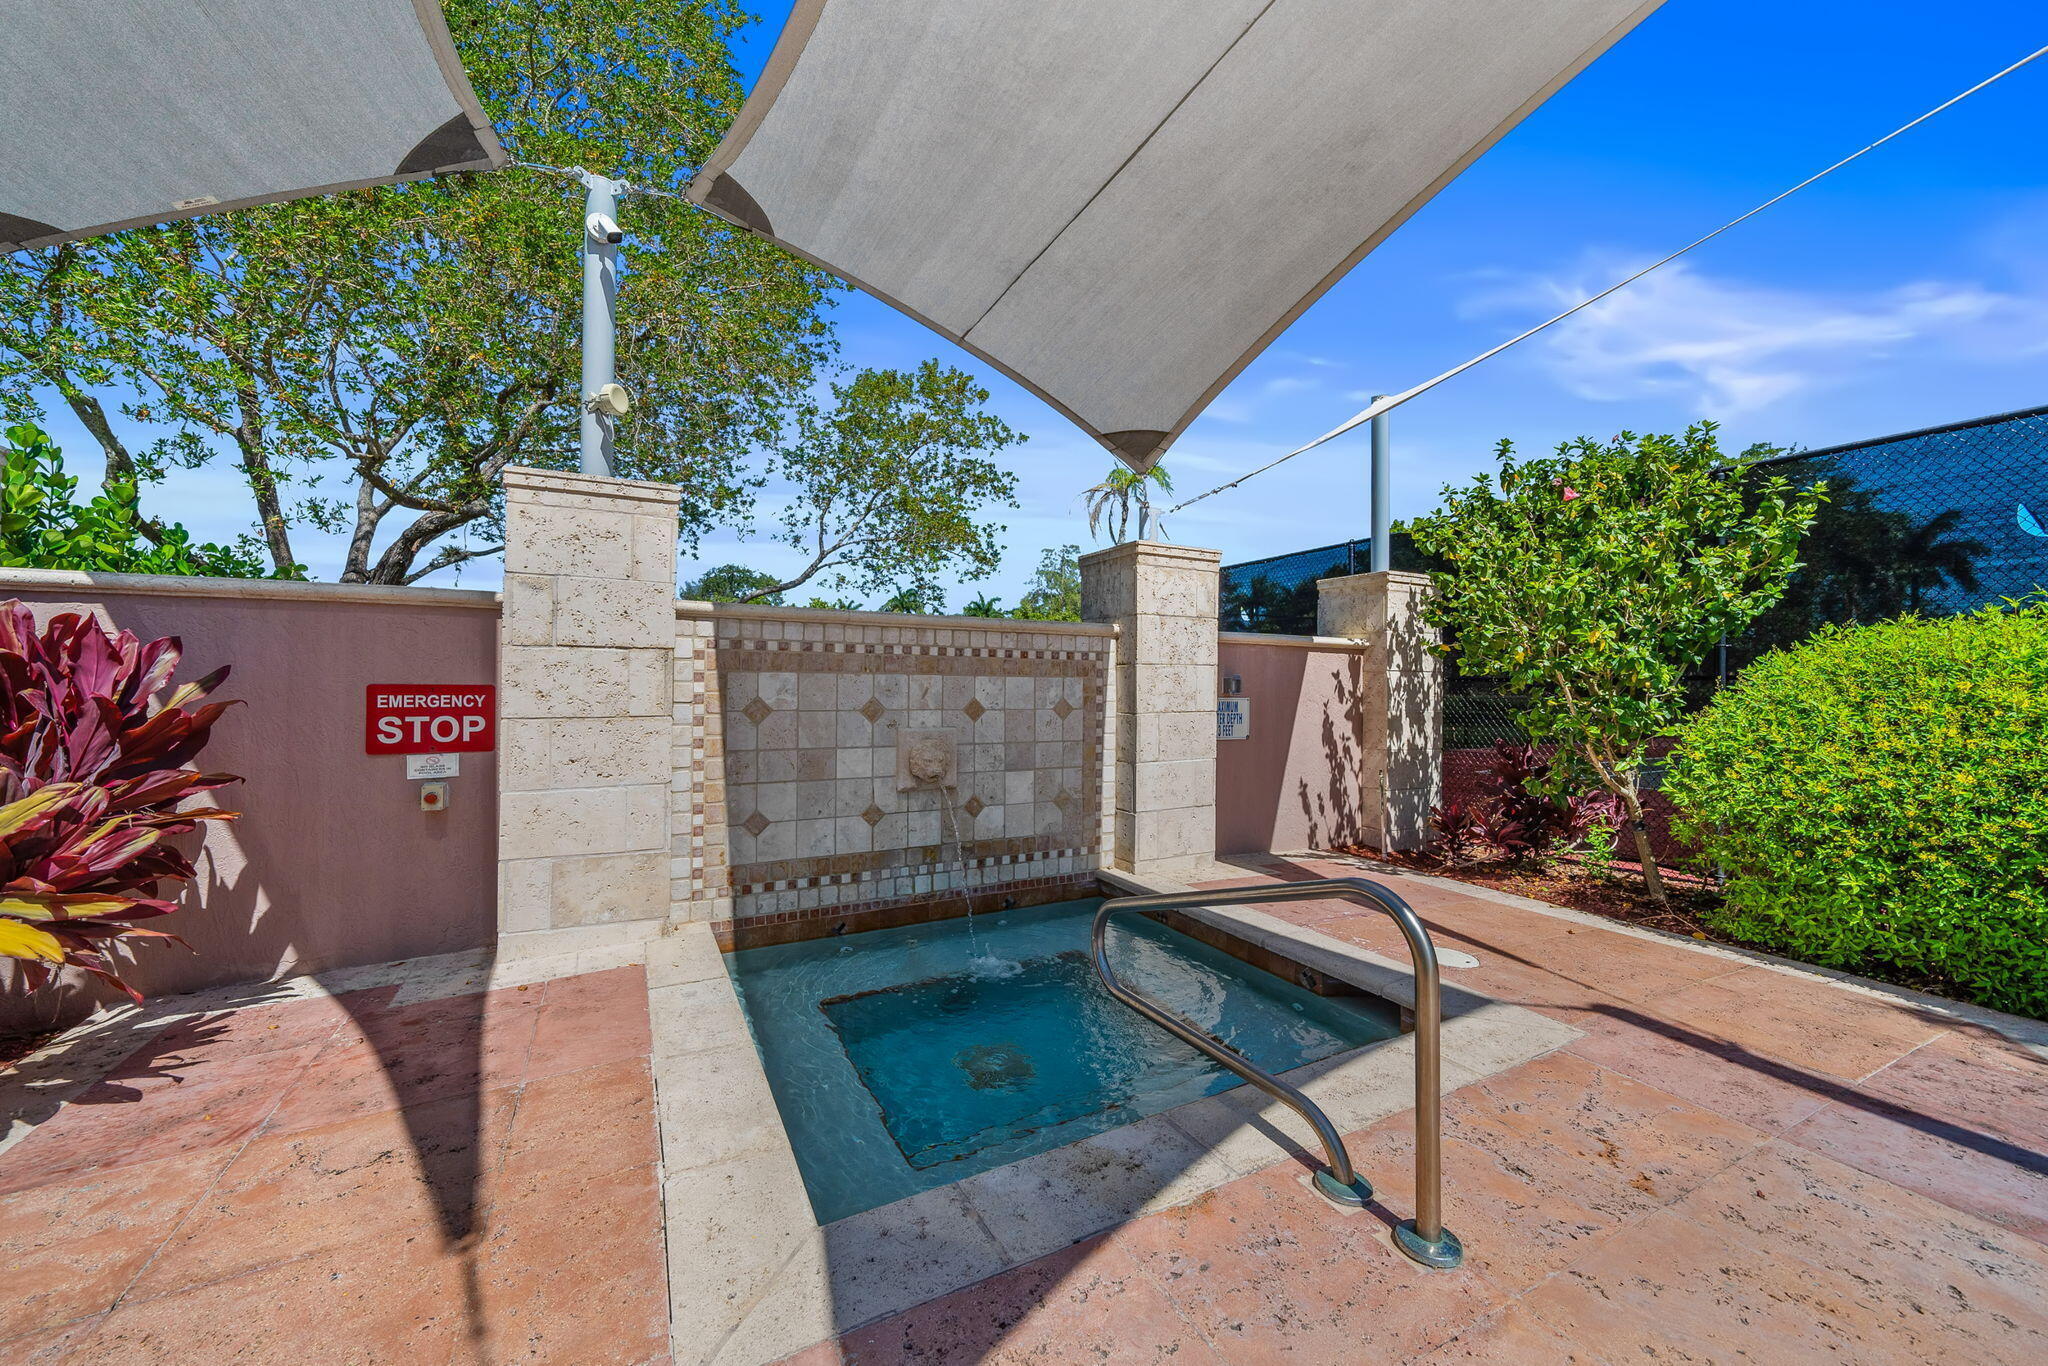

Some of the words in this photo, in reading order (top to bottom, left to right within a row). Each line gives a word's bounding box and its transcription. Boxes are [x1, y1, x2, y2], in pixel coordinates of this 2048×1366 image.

[377, 694, 486, 708] EMERGENCY
[1217, 701, 1238, 712] AXIMUM
[1227, 713, 1242, 724] DEPTH
[377, 715, 486, 744] STOP
[1222, 725, 1233, 736] FEET
